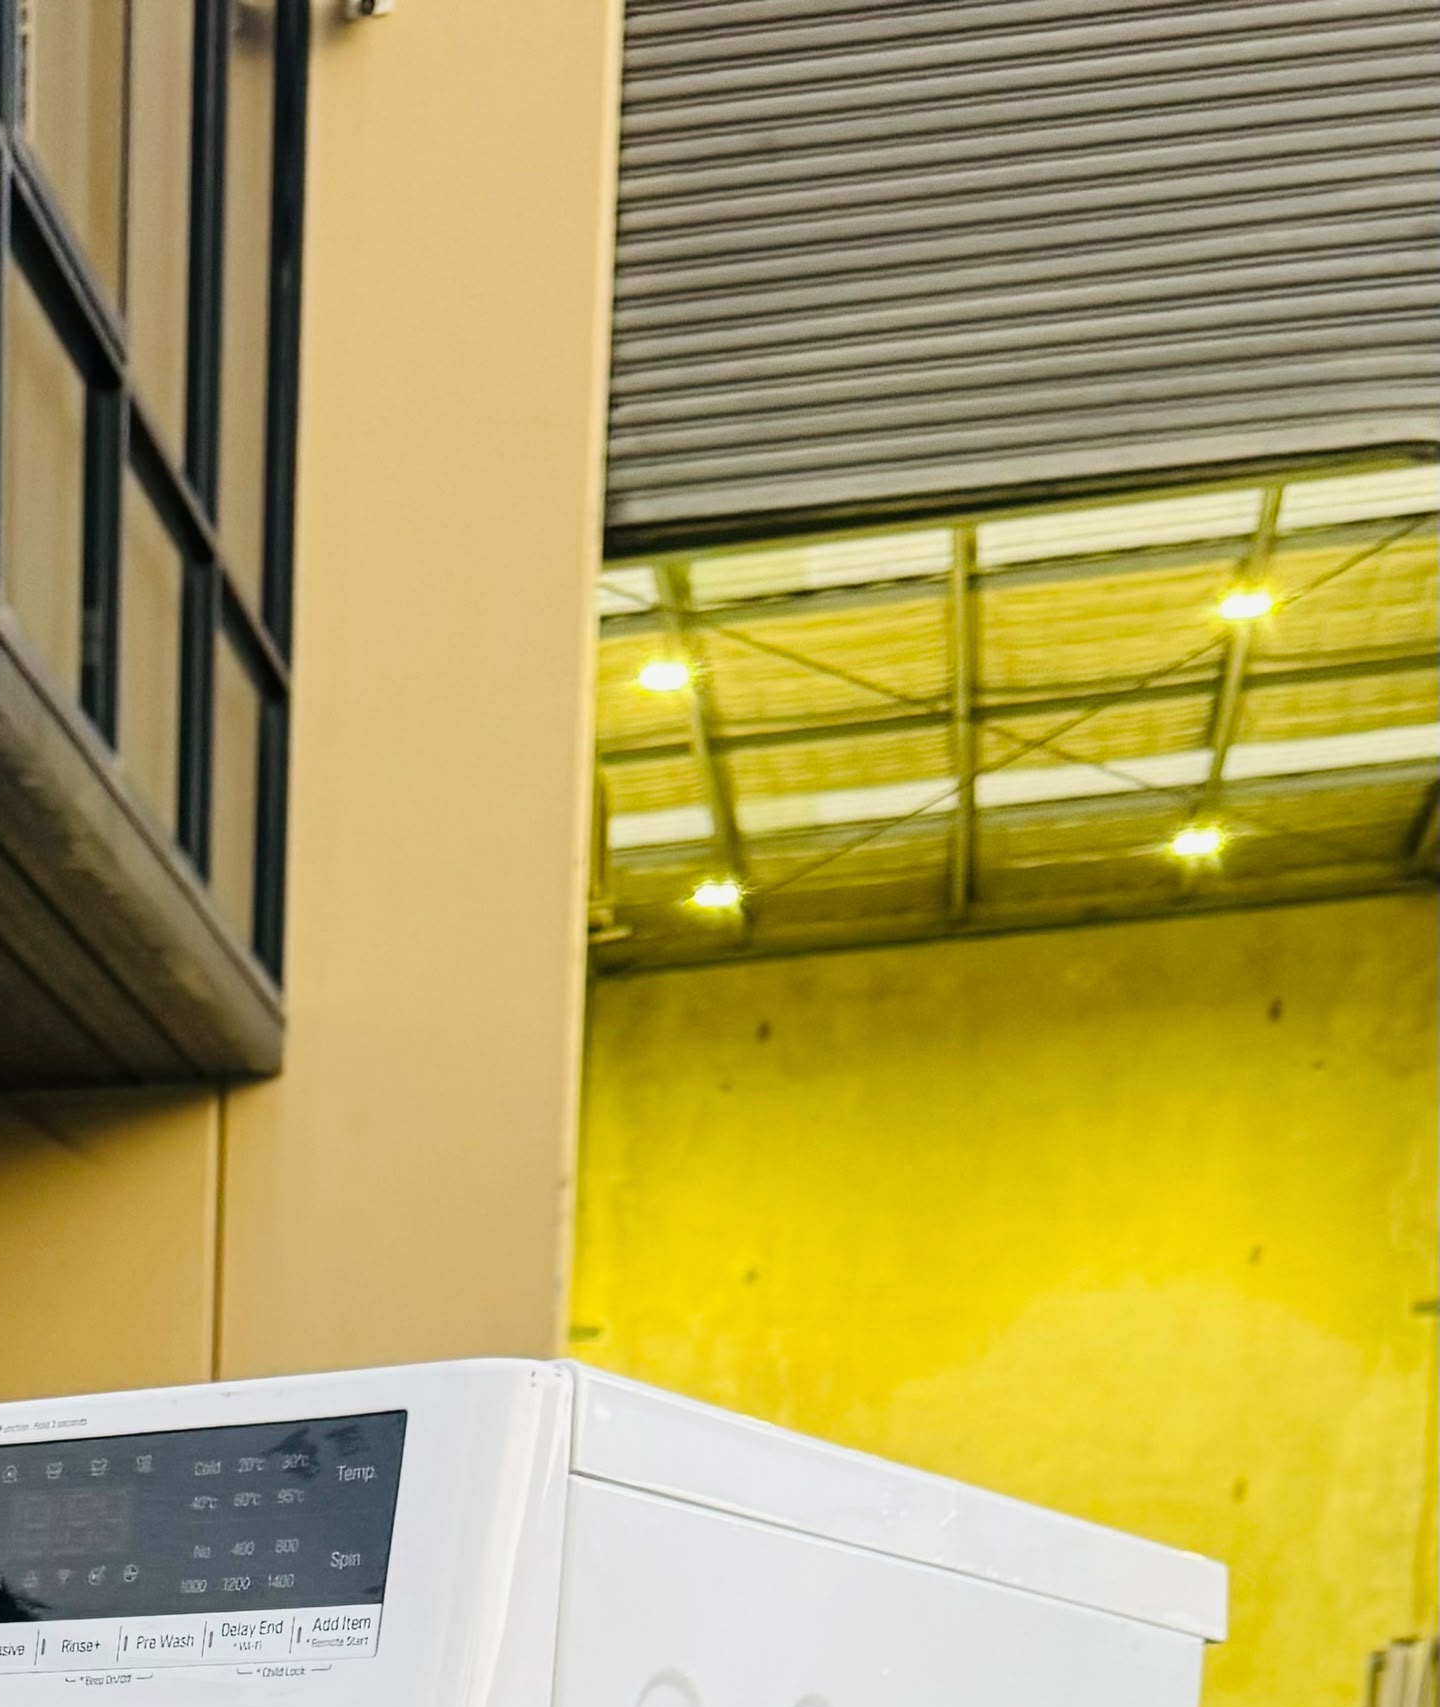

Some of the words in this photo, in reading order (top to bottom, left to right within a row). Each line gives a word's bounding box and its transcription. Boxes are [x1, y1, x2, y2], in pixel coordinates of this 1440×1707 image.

[330, 1551, 361, 1570] Spin
[222, 1576, 251, 1591] 1200
[221, 1622, 256, 1638] Delay
[260, 1620, 283, 1635] End
[312, 1616, 340, 1632] Add
[342, 1615, 371, 1631] Item
[61, 1639, 101, 1653] Rinse+
[136, 1636, 156, 1650] Pre
[160, 1634, 195, 1649] Wash
